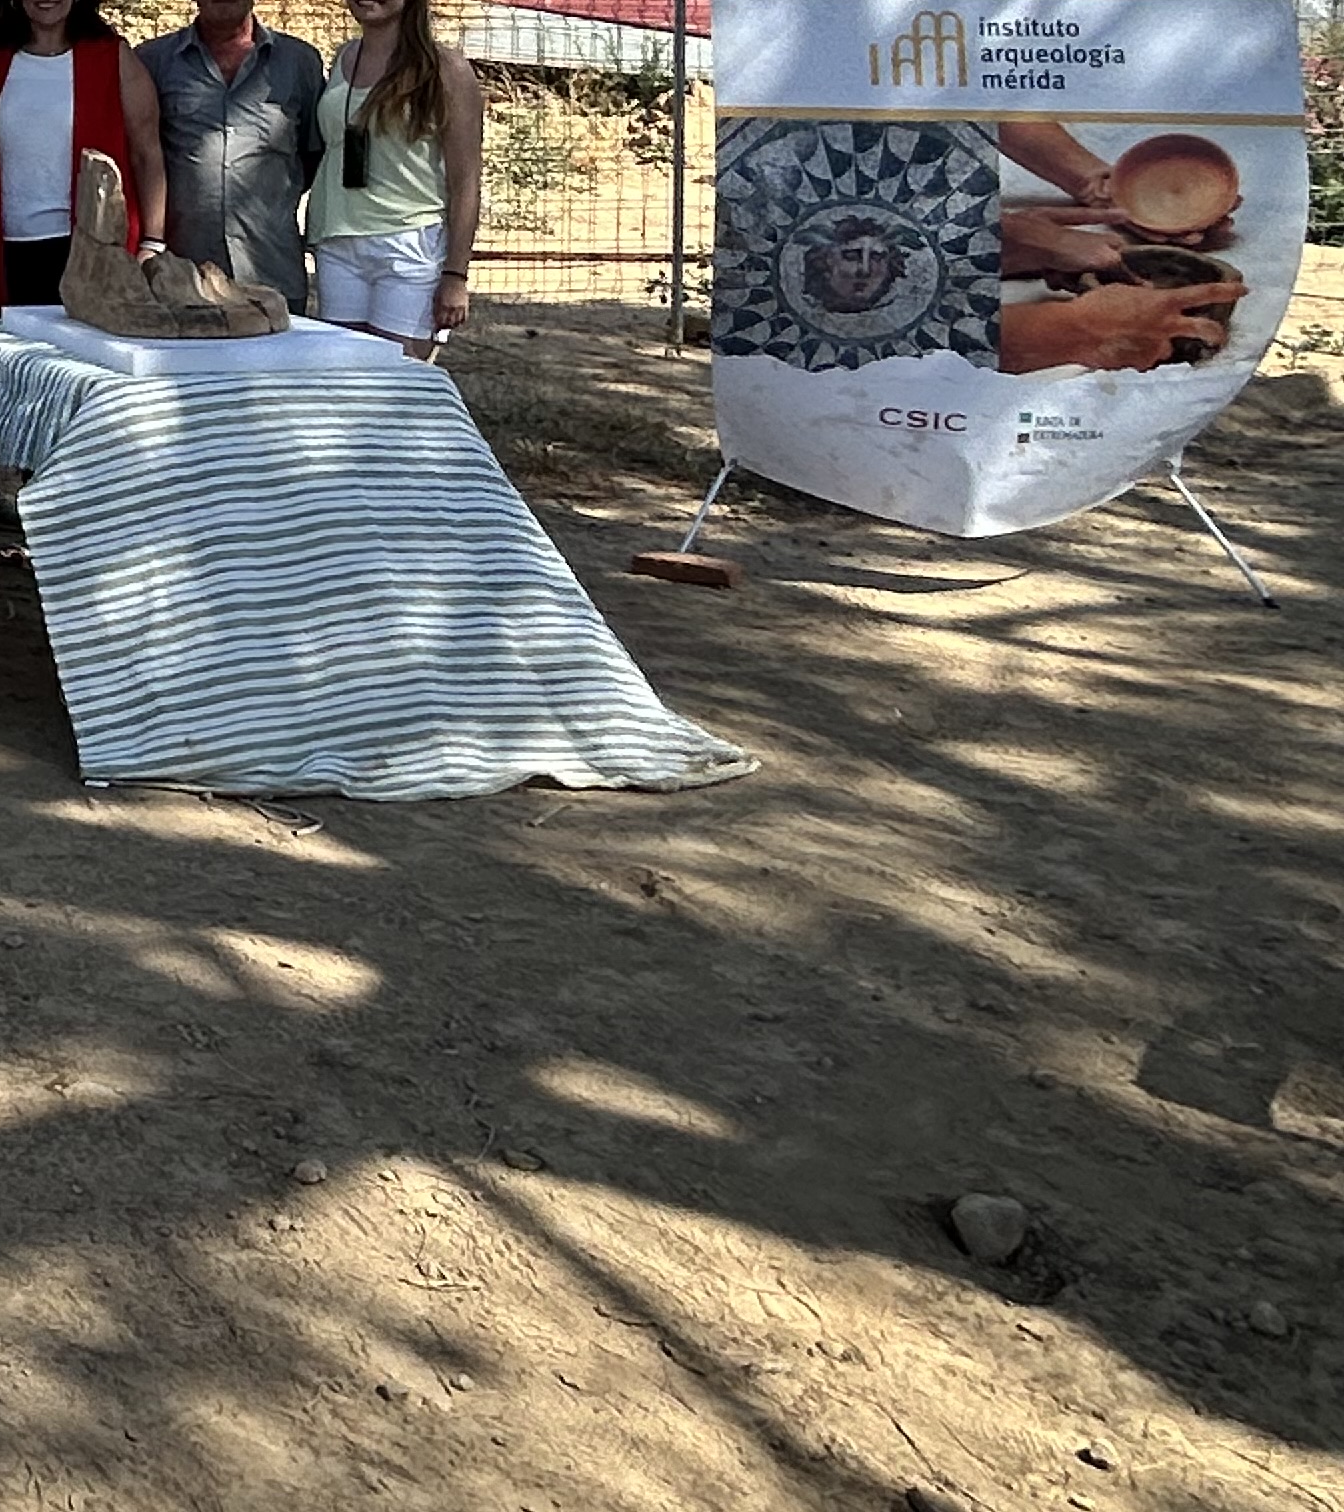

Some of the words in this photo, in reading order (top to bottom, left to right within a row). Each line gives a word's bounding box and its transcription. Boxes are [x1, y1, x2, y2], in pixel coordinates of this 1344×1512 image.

[977, 16, 1081, 38] instituto
[979, 43, 1126, 69] arqueología
[981, 68, 1067, 91] mérida
[878, 406, 968, 433] CSIC
